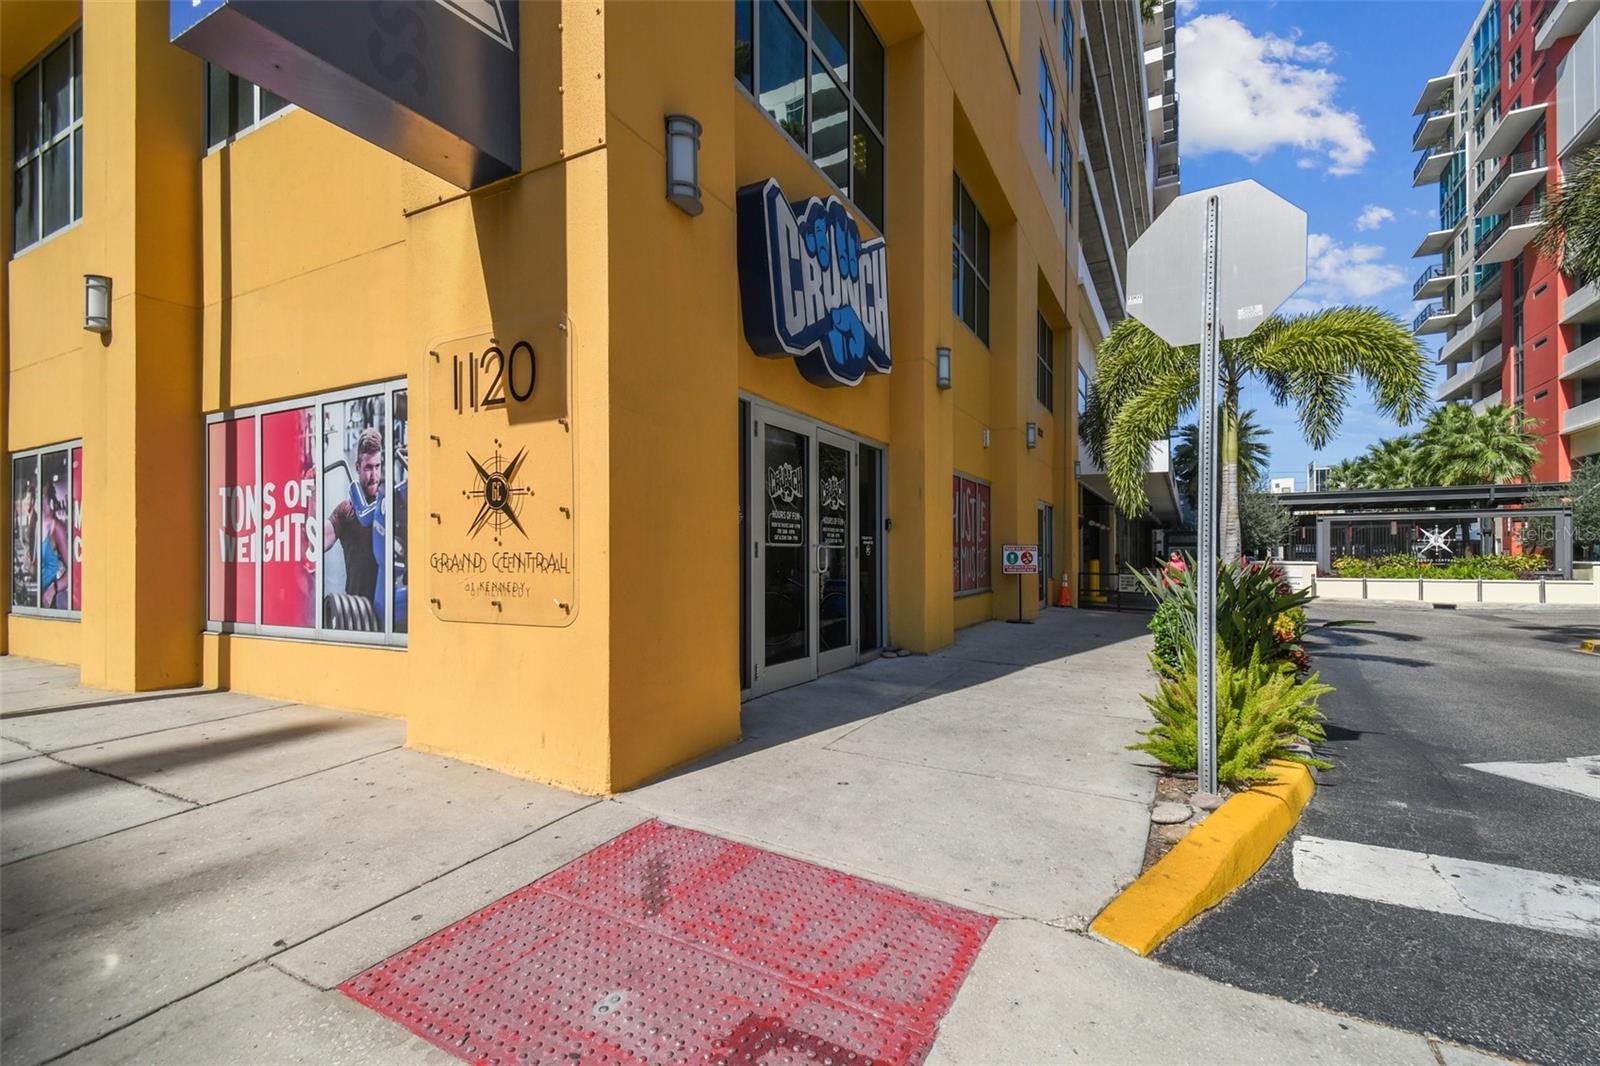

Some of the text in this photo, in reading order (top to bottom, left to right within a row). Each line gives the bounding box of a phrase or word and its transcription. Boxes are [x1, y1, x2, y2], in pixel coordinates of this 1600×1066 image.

[776, 193, 888, 355] CRUNCH
[453, 340, 536, 411] 1120
[219, 479, 315, 532] TONS OF
[219, 512, 316, 563] WEIGHTS
[430, 551, 567, 569] GRAND CENTRAL
[479, 581, 526, 593] KENNEDY
